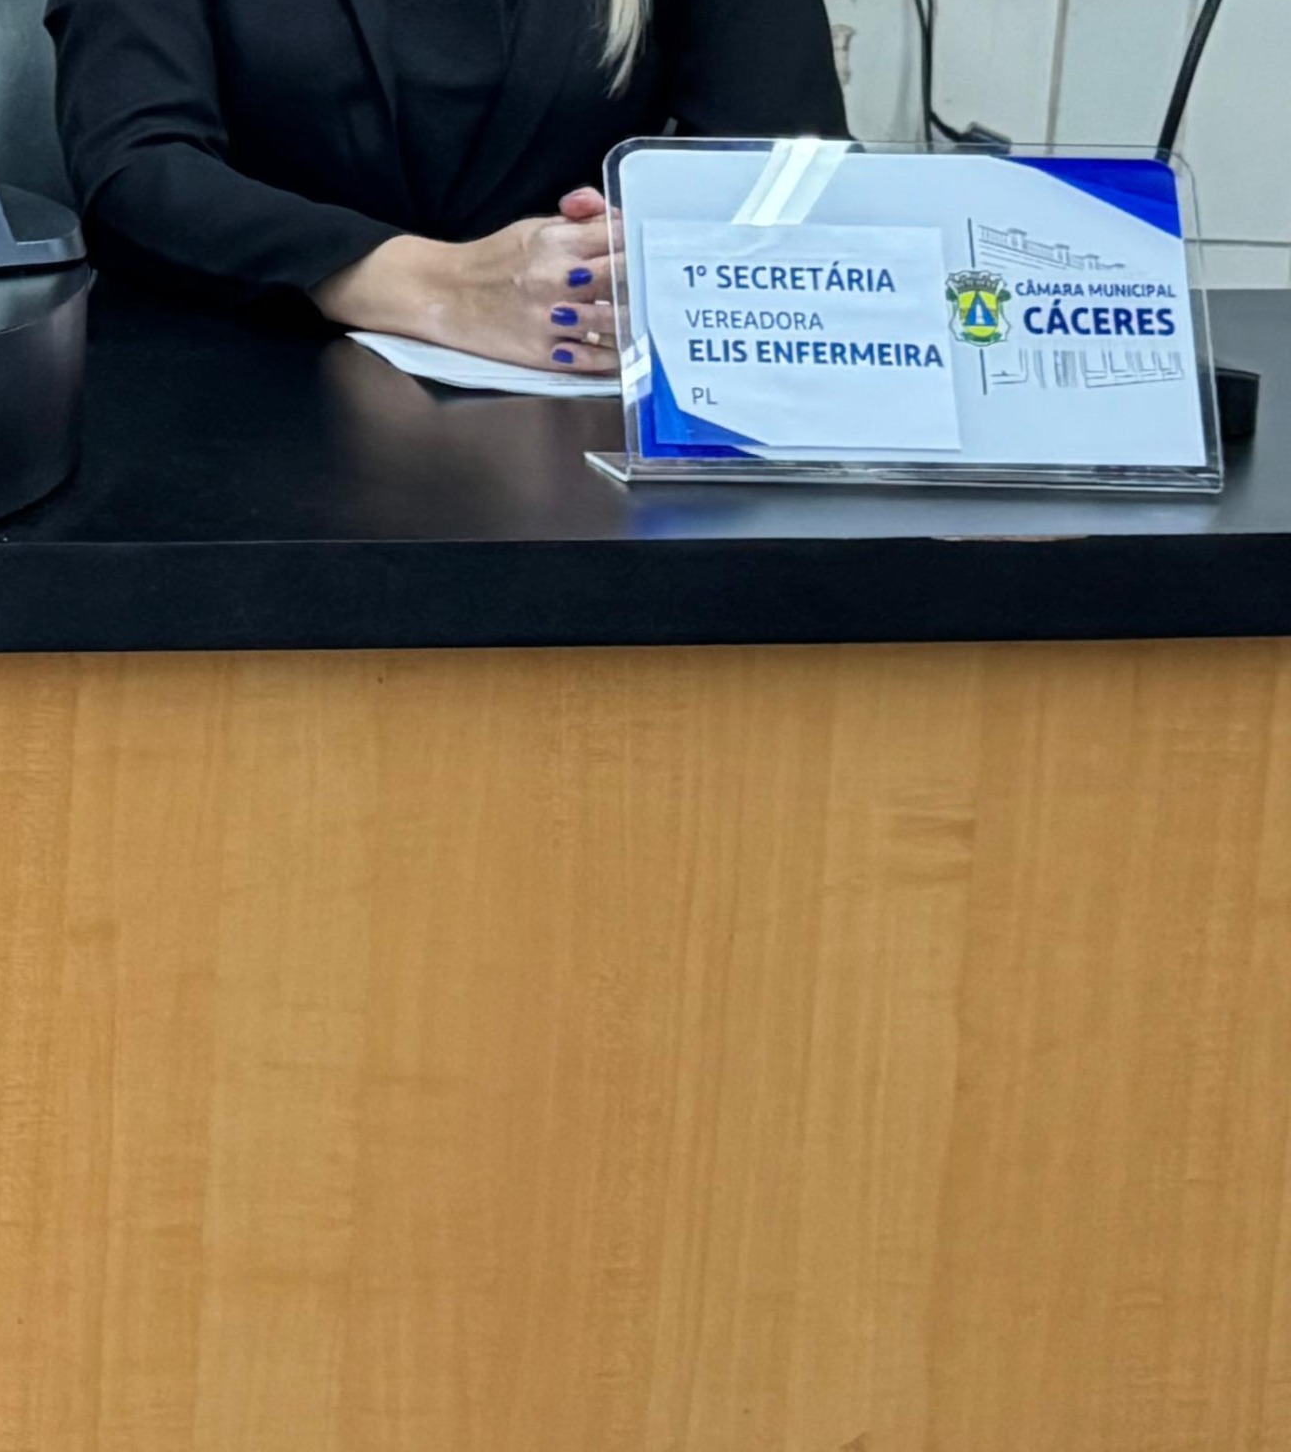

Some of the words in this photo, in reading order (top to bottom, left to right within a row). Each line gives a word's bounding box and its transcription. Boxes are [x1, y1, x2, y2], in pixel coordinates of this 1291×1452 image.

[716, 261, 895, 292] SECRETÁRIA
[1015, 279, 1085, 297] CÂMARA
[1088, 283, 1176, 298] MUNICIPAL
[686, 309, 824, 330] VEREADORA
[1023, 299, 1175, 336] CÁCERES
[688, 339, 747, 363] ELIS
[756, 340, 944, 367] ENFERMEIRA
[691, 387, 718, 405] PL
